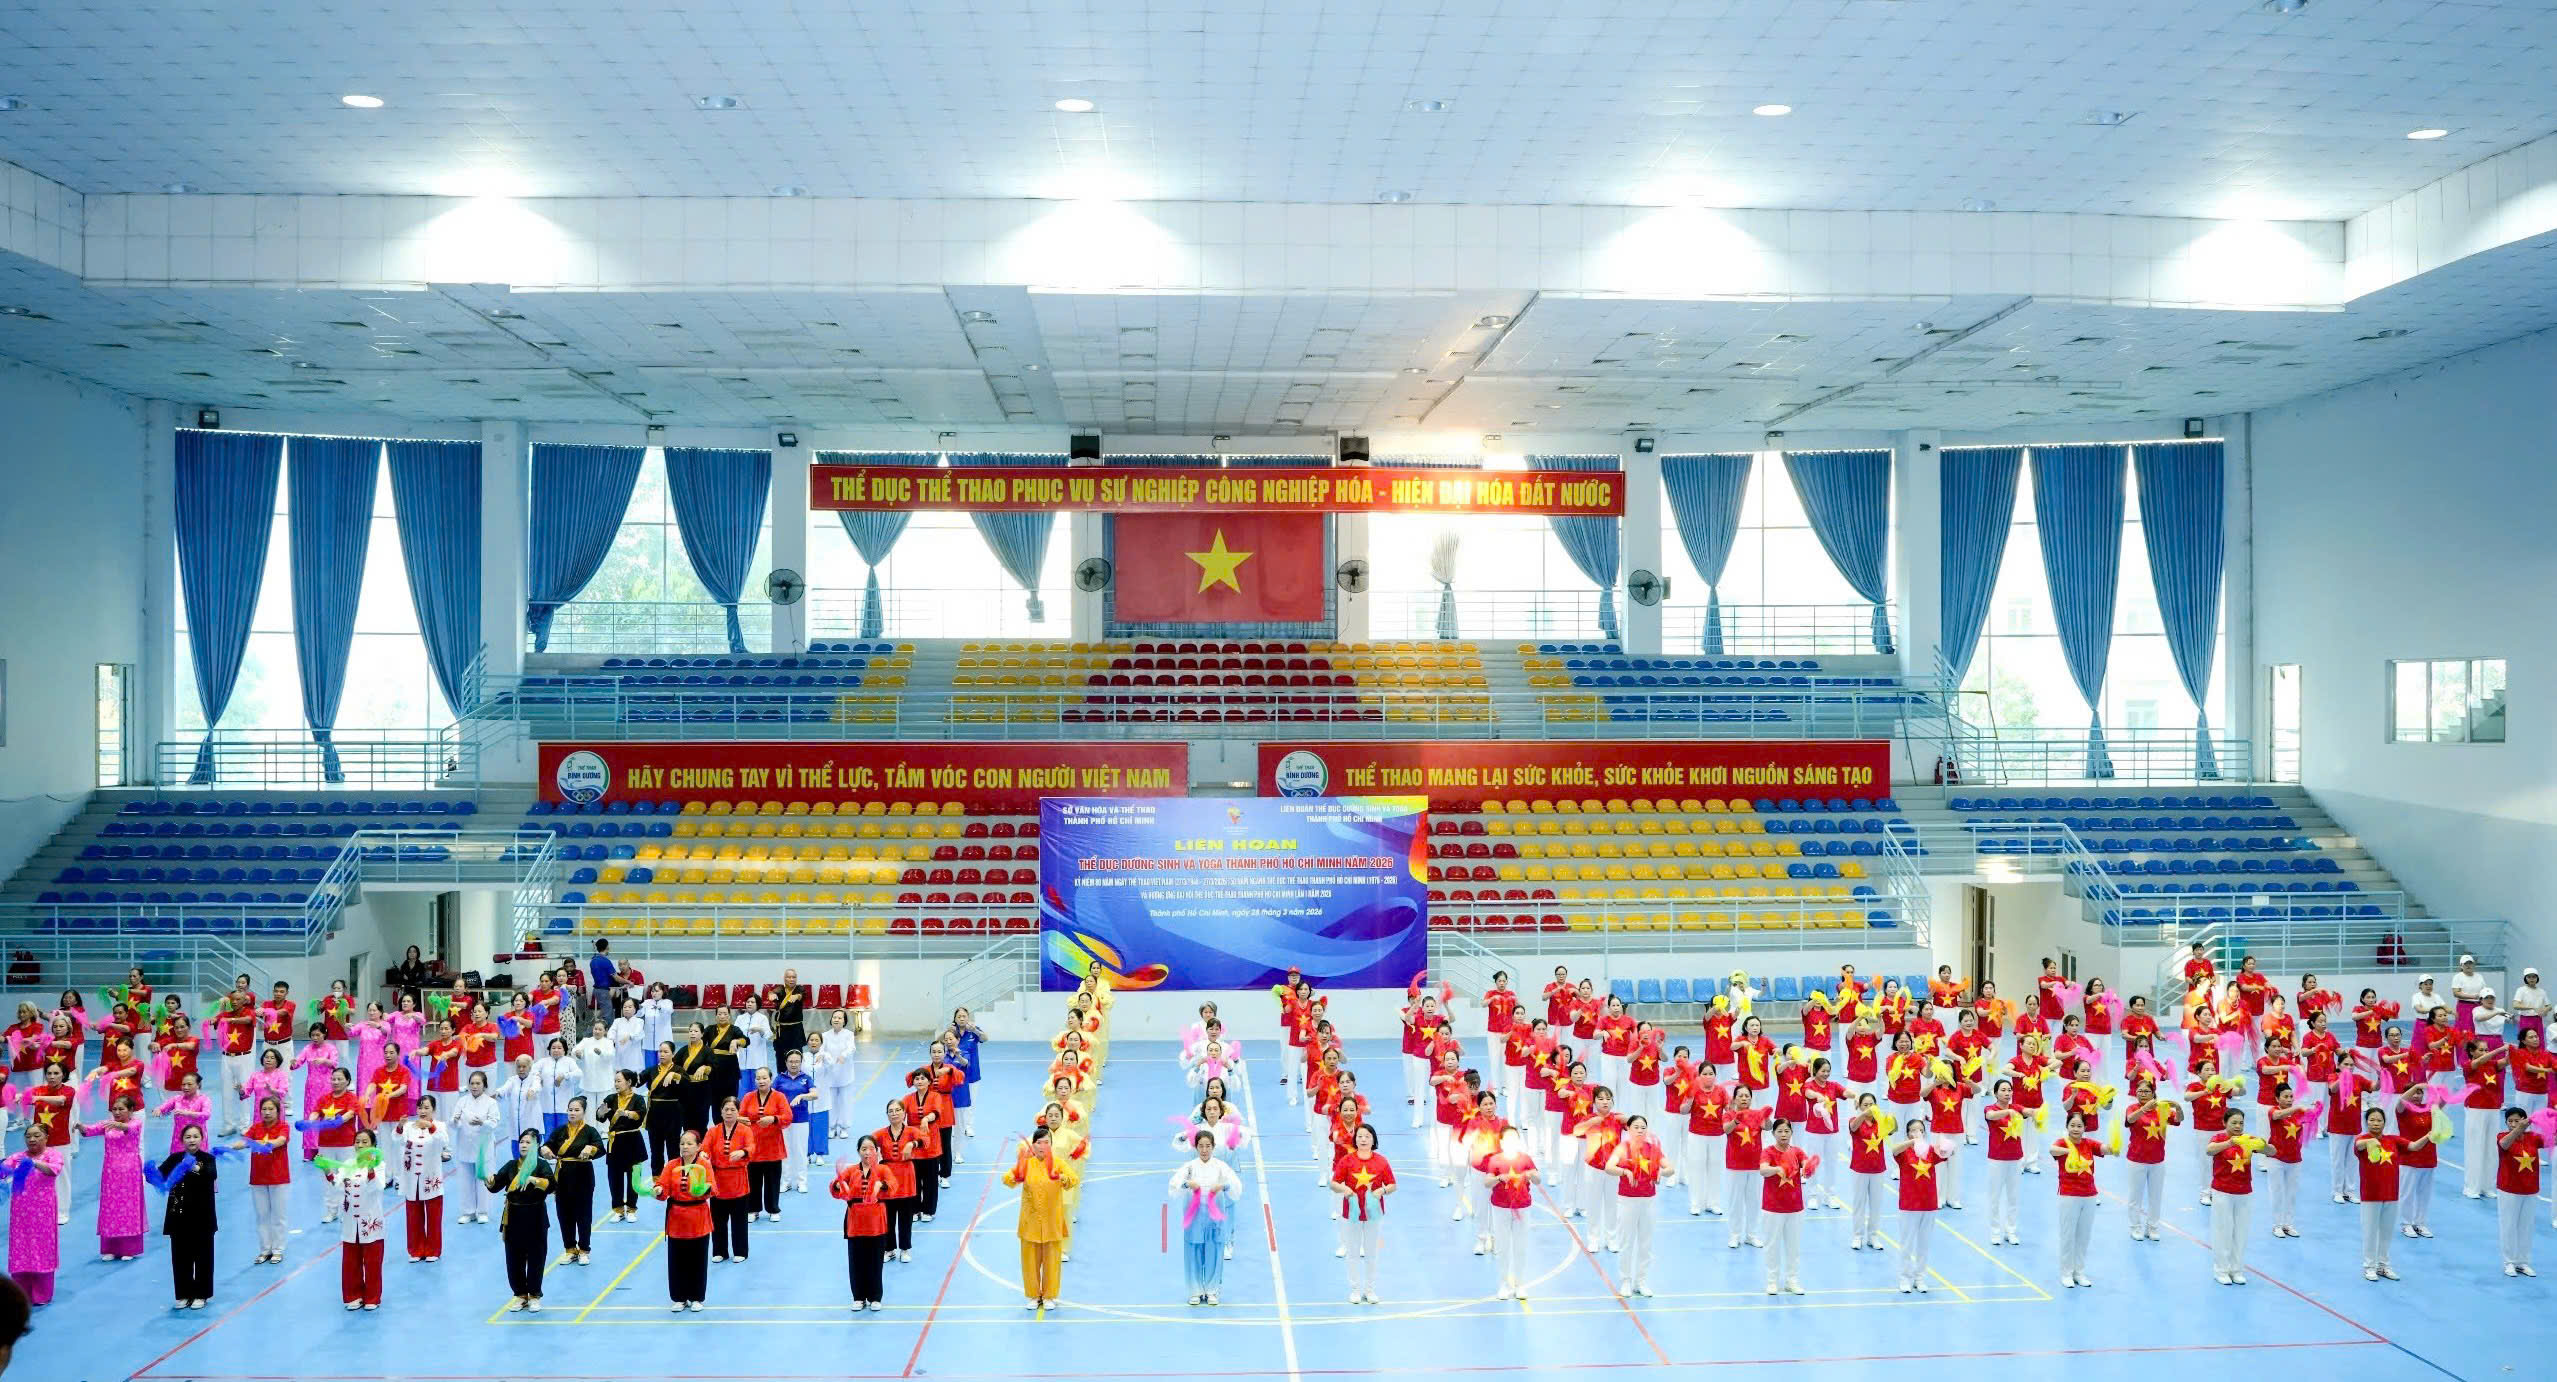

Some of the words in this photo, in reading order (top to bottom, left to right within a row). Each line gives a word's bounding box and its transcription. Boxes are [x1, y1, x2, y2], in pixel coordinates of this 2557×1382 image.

[831, 469, 866, 501] THỂ
[872, 477, 911, 507] DỤC
[917, 470, 952, 502] THỂ
[957, 479, 1006, 502] THAO
[1012, 478, 1063, 507] PHỤC
[1069, 478, 1096, 507] VỤ
[1101, 475, 1128, 507] SỰ
[1132, 474, 1199, 508] NGHIỆP
[1205, 475, 1256, 503] CÔNG
[1263, 475, 1330, 508] NGHIỆP
[1336, 476, 1373, 503] HÓA
[1392, 477, 1434, 508] HIỆN
[1477, 477, 1514, 504] HÓA
[1520, 475, 1555, 505] ĐẤT
[1561, 478, 1611, 507] NƯỚC
[628, 763, 665, 789] HÃY
[670, 767, 734, 789] CHUNG
[739, 767, 770, 788] TAY
[776, 762, 793, 789] VÌ
[799, 760, 834, 789] THỂ
[839, 766, 880, 793] LỰC,
[885, 761, 926, 789] TẦM
[931, 764, 968, 789] VÓC
[973, 768, 1013, 789] CON
[1018, 764, 1077, 789] NGƯỜI
[1082, 763, 1121, 792] VIỆT
[1126, 768, 1170, 789] NAM
[1345, 761, 1377, 787] THỂ
[1381, 767, 1423, 787] THAO
[1428, 768, 1478, 787] MANG
[1482, 767, 1509, 790] LẠI
[1513, 763, 1547, 787] SỨC
[1551, 761, 1599, 788] KHỎE,
[1604, 763, 1637, 786] SỨC
[1642, 761, 1684, 786] KHỎE
[1689, 764, 1728, 785] KHƠI
[1732, 761, 1789, 785] NGUỒN
[1793, 763, 1838, 786] SÁNG
[1842, 766, 1873, 789] TẠO
[1075, 805, 1090, 814] VĂN
[1063, 816, 1089, 825] THÀNH
[1090, 815, 1106, 825] PHỐ
[1175, 838, 1224, 851] LIÊN
[1232, 839, 1298, 851] HOAN
[1078, 855, 1098, 871] THỂ
[1099, 858, 1120, 873] DỤC
[1121, 856, 1155, 871] DƯỠNG
[1157, 858, 1181, 870] SINH
[1198, 858, 1223, 870] YOGA
[1225, 856, 1257, 870] THÀNH
[1297, 856, 1314, 869] CHÍ
[1316, 858, 1343, 869] MINH
[1345, 855, 1368, 869] NĂM
[1369, 857, 1394, 869] 2026
